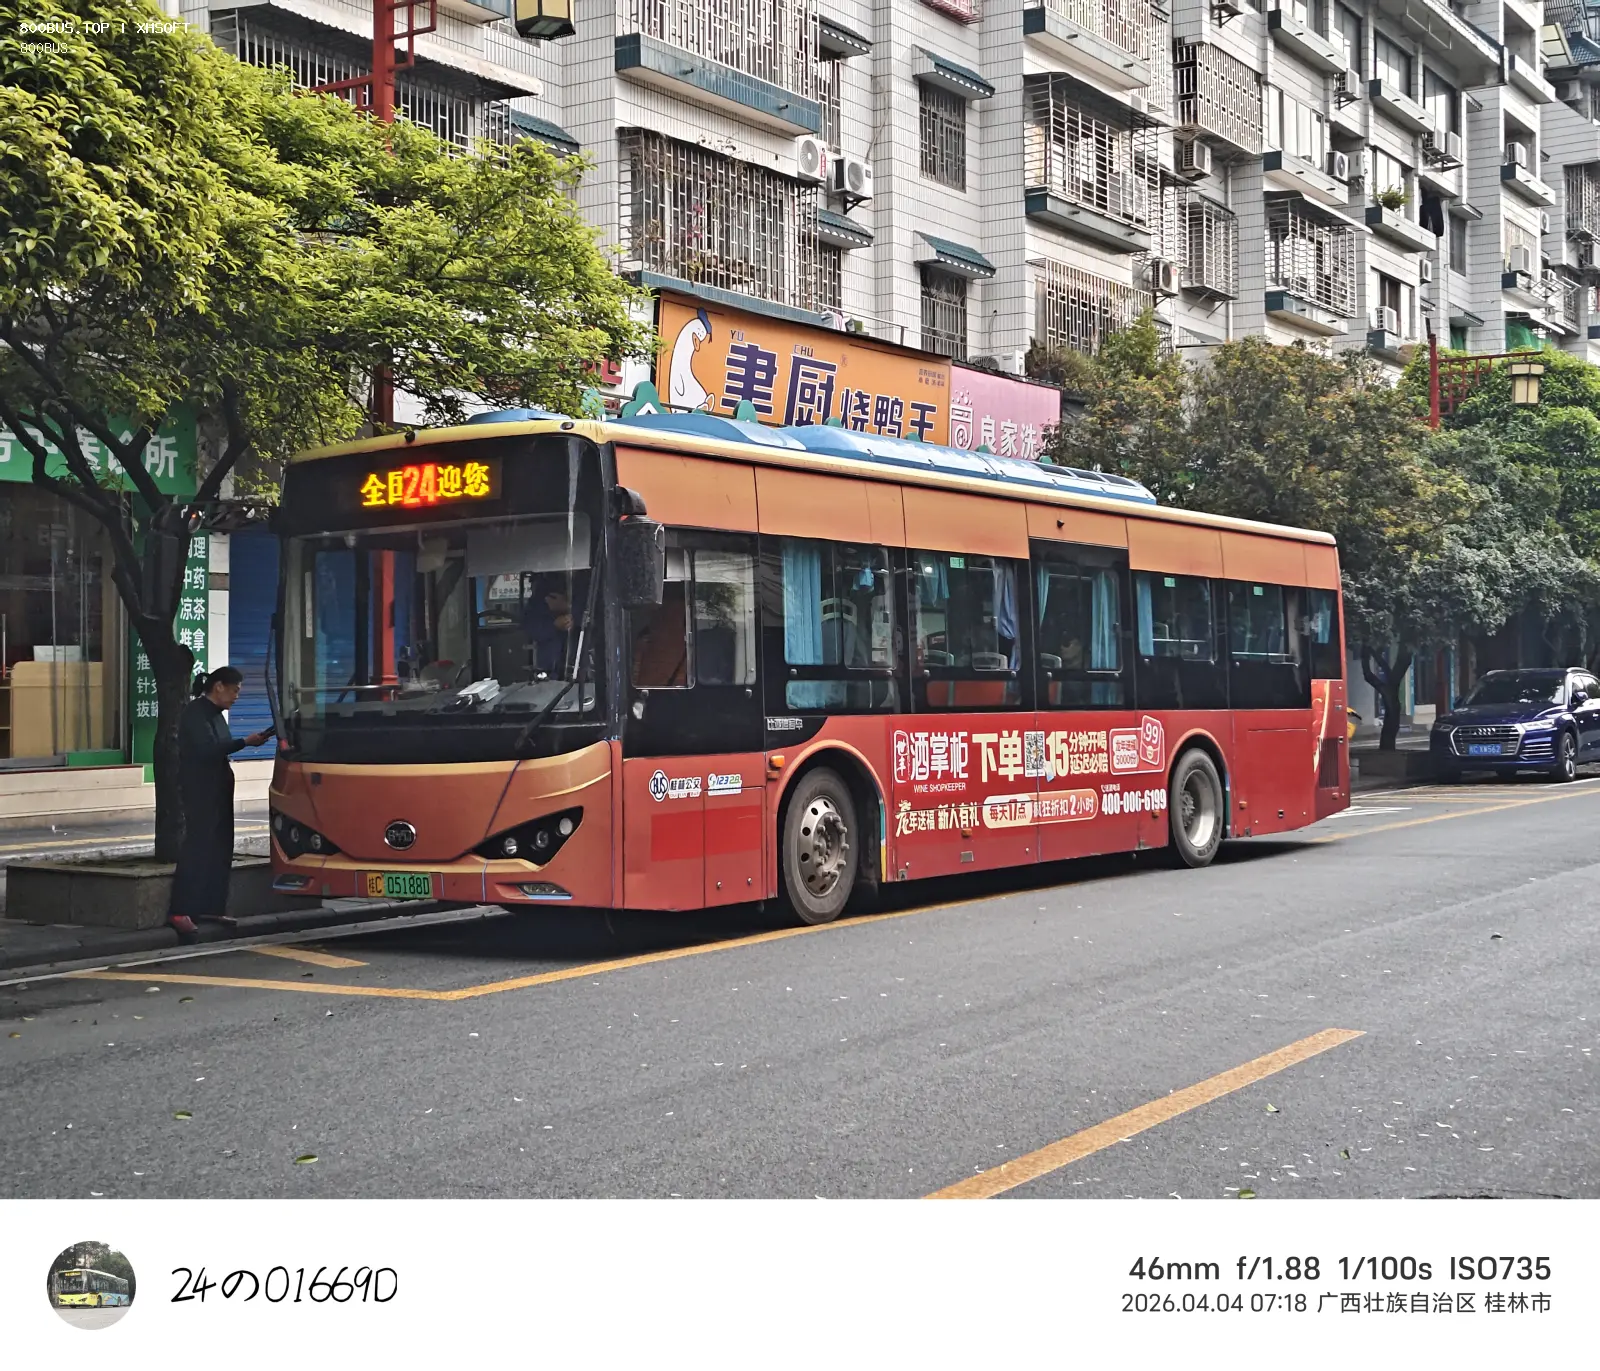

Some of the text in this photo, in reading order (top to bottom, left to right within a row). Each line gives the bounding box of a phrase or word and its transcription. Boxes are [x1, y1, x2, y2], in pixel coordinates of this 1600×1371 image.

[980, 414, 1060, 460] 良家洗
[183, 566, 206, 589] 中药
[180, 597, 206, 620] 凉茶
[180, 628, 206, 652] 推拿
[909, 731, 969, 780] 酒掌柜
[972, 730, 1024, 782] 下单
[1045, 730, 1069, 777] 15
[913, 782, 966, 793] WINE SHOPKEEPER
[1101, 788, 1167, 815] 400-006-6199
[938, 801, 980, 830] 新人有礼
